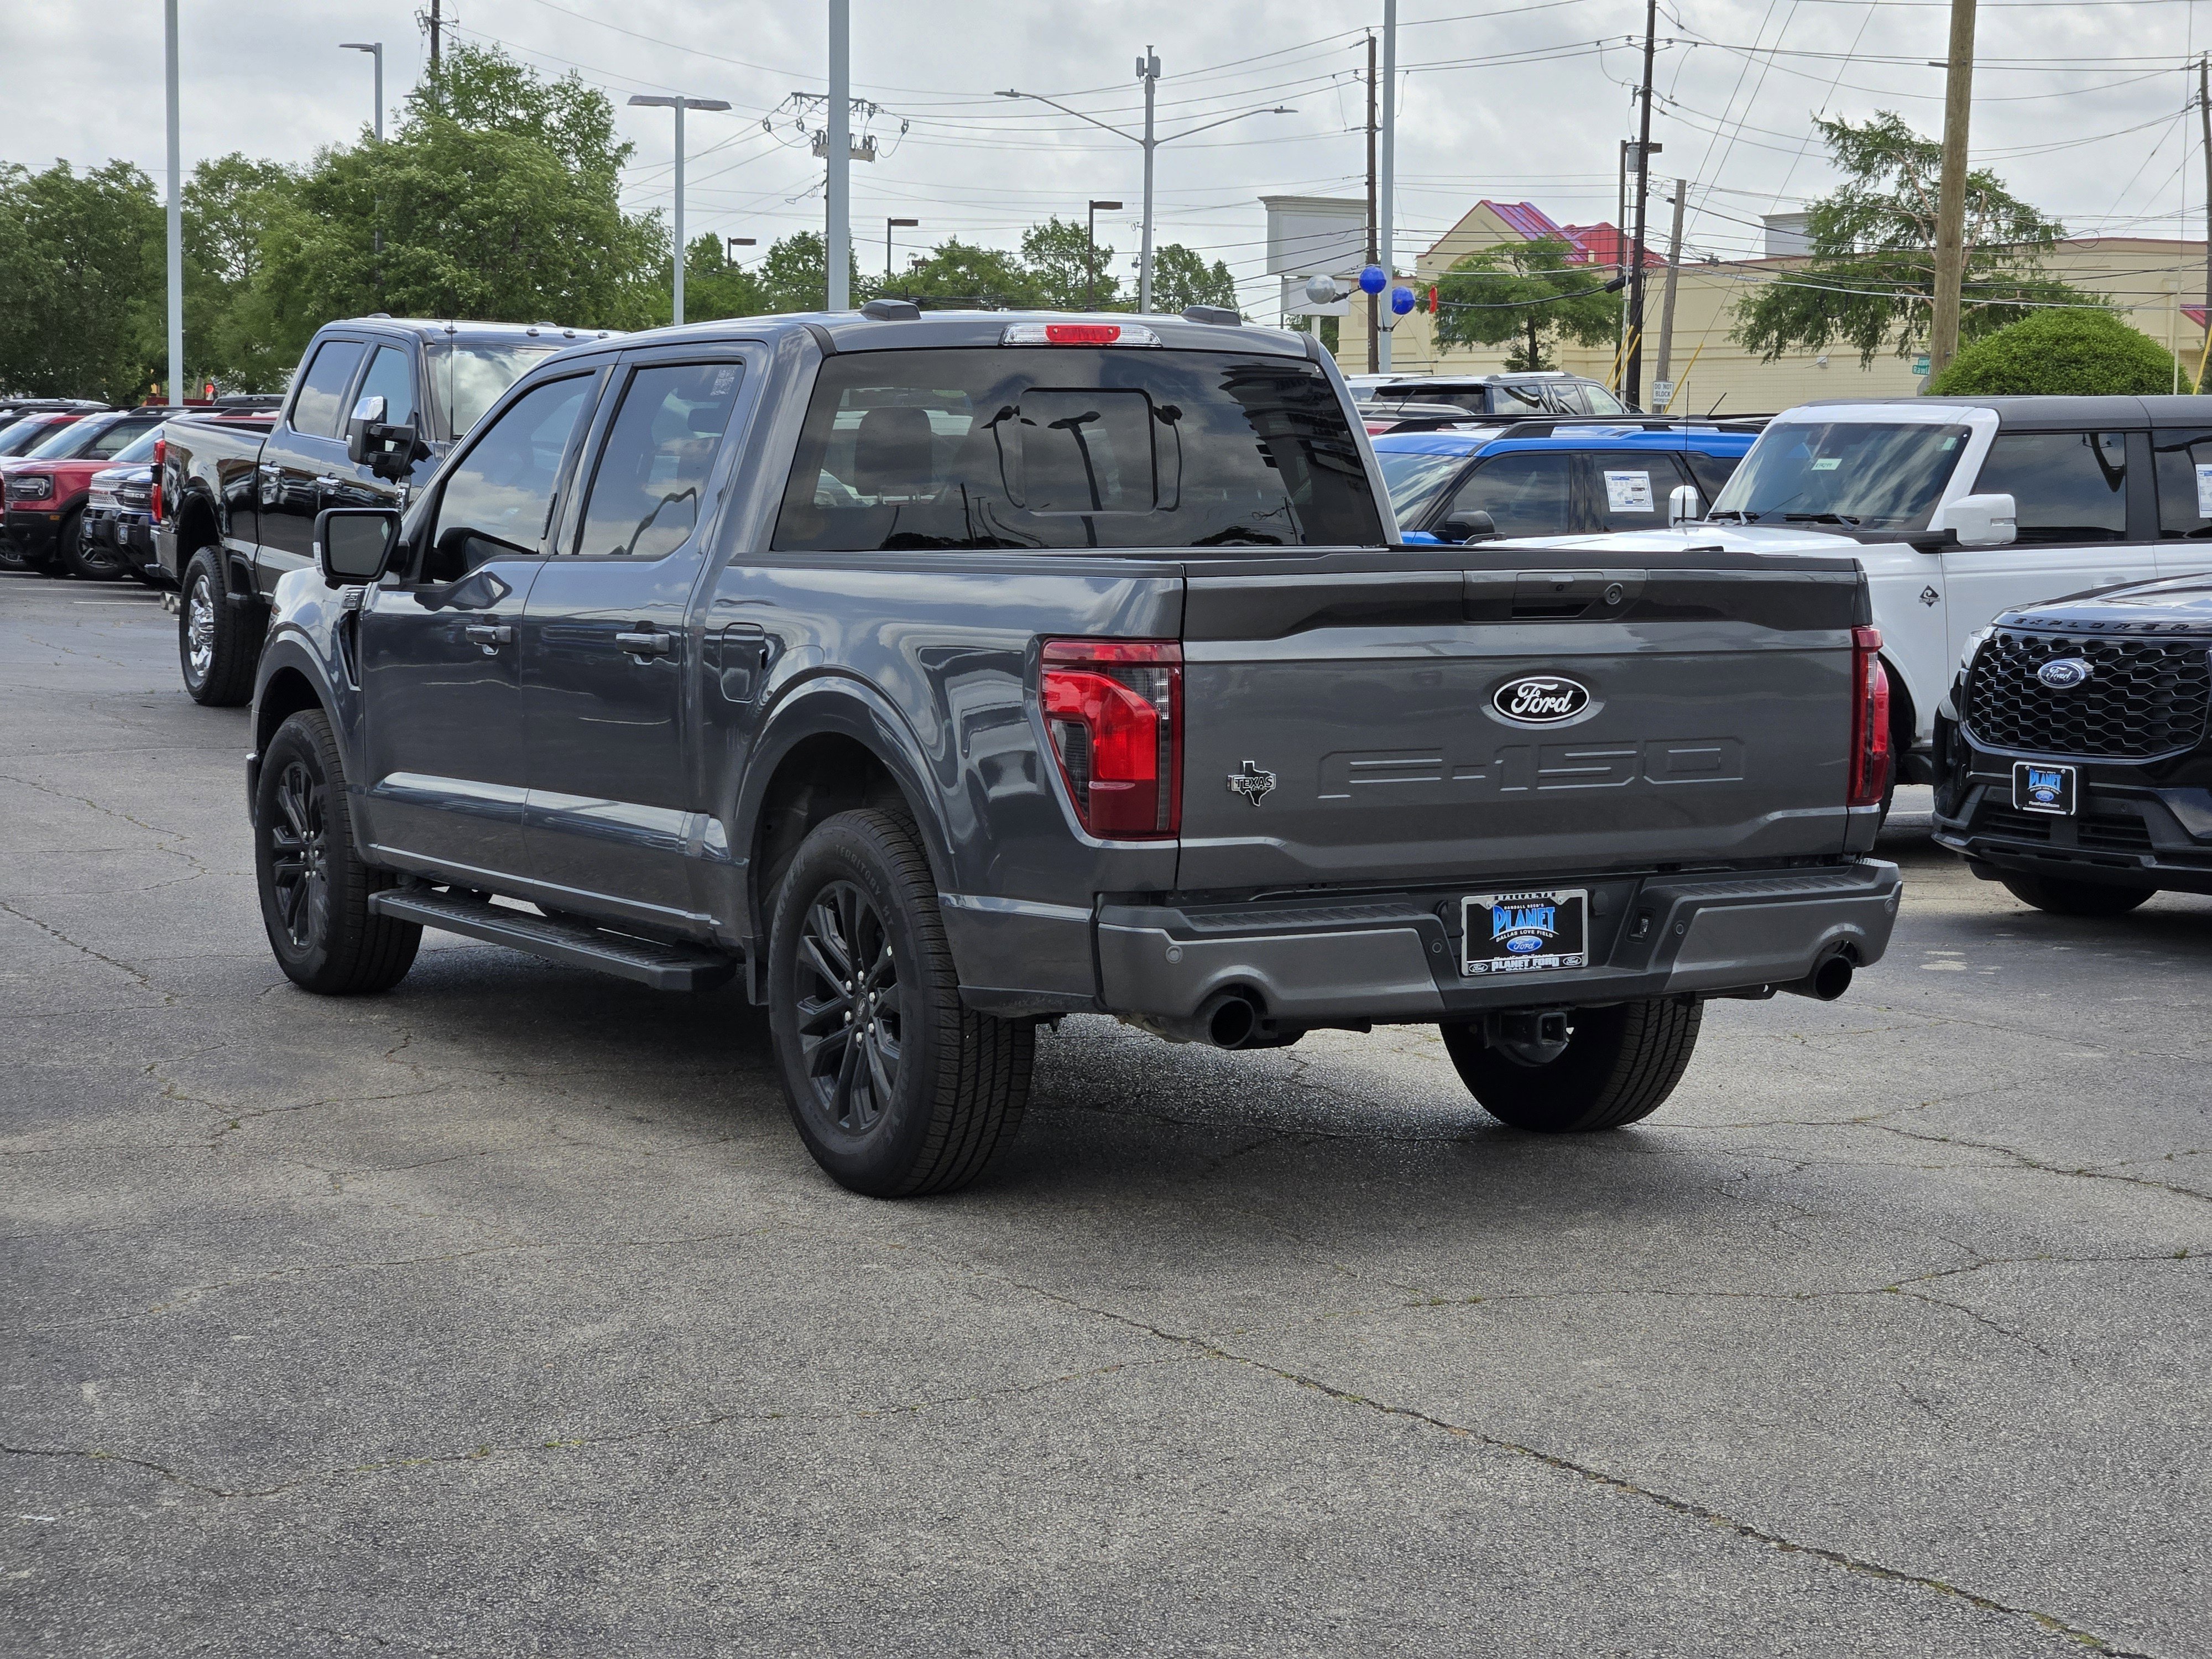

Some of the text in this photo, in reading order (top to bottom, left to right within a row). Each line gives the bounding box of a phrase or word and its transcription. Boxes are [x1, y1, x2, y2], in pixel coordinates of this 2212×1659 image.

[2013, 618, 2190, 630] EXPLORER
[2046, 666, 2073, 682] Ford
[1511, 683, 1573, 713] Ford
[1318, 737, 1744, 799] F-150
[1233, 777, 1273, 788] TEXAS
[2029, 769, 2061, 789] PLANET
[836, 844, 880, 895] TERRITORY
[1493, 905, 1556, 936] PLANET
[1496, 931, 1518, 942] DALLAS
[1537, 930, 1553, 938] FIELD
[1514, 939, 1535, 950] Ford
[1491, 957, 1559, 972] PLANET FORD
